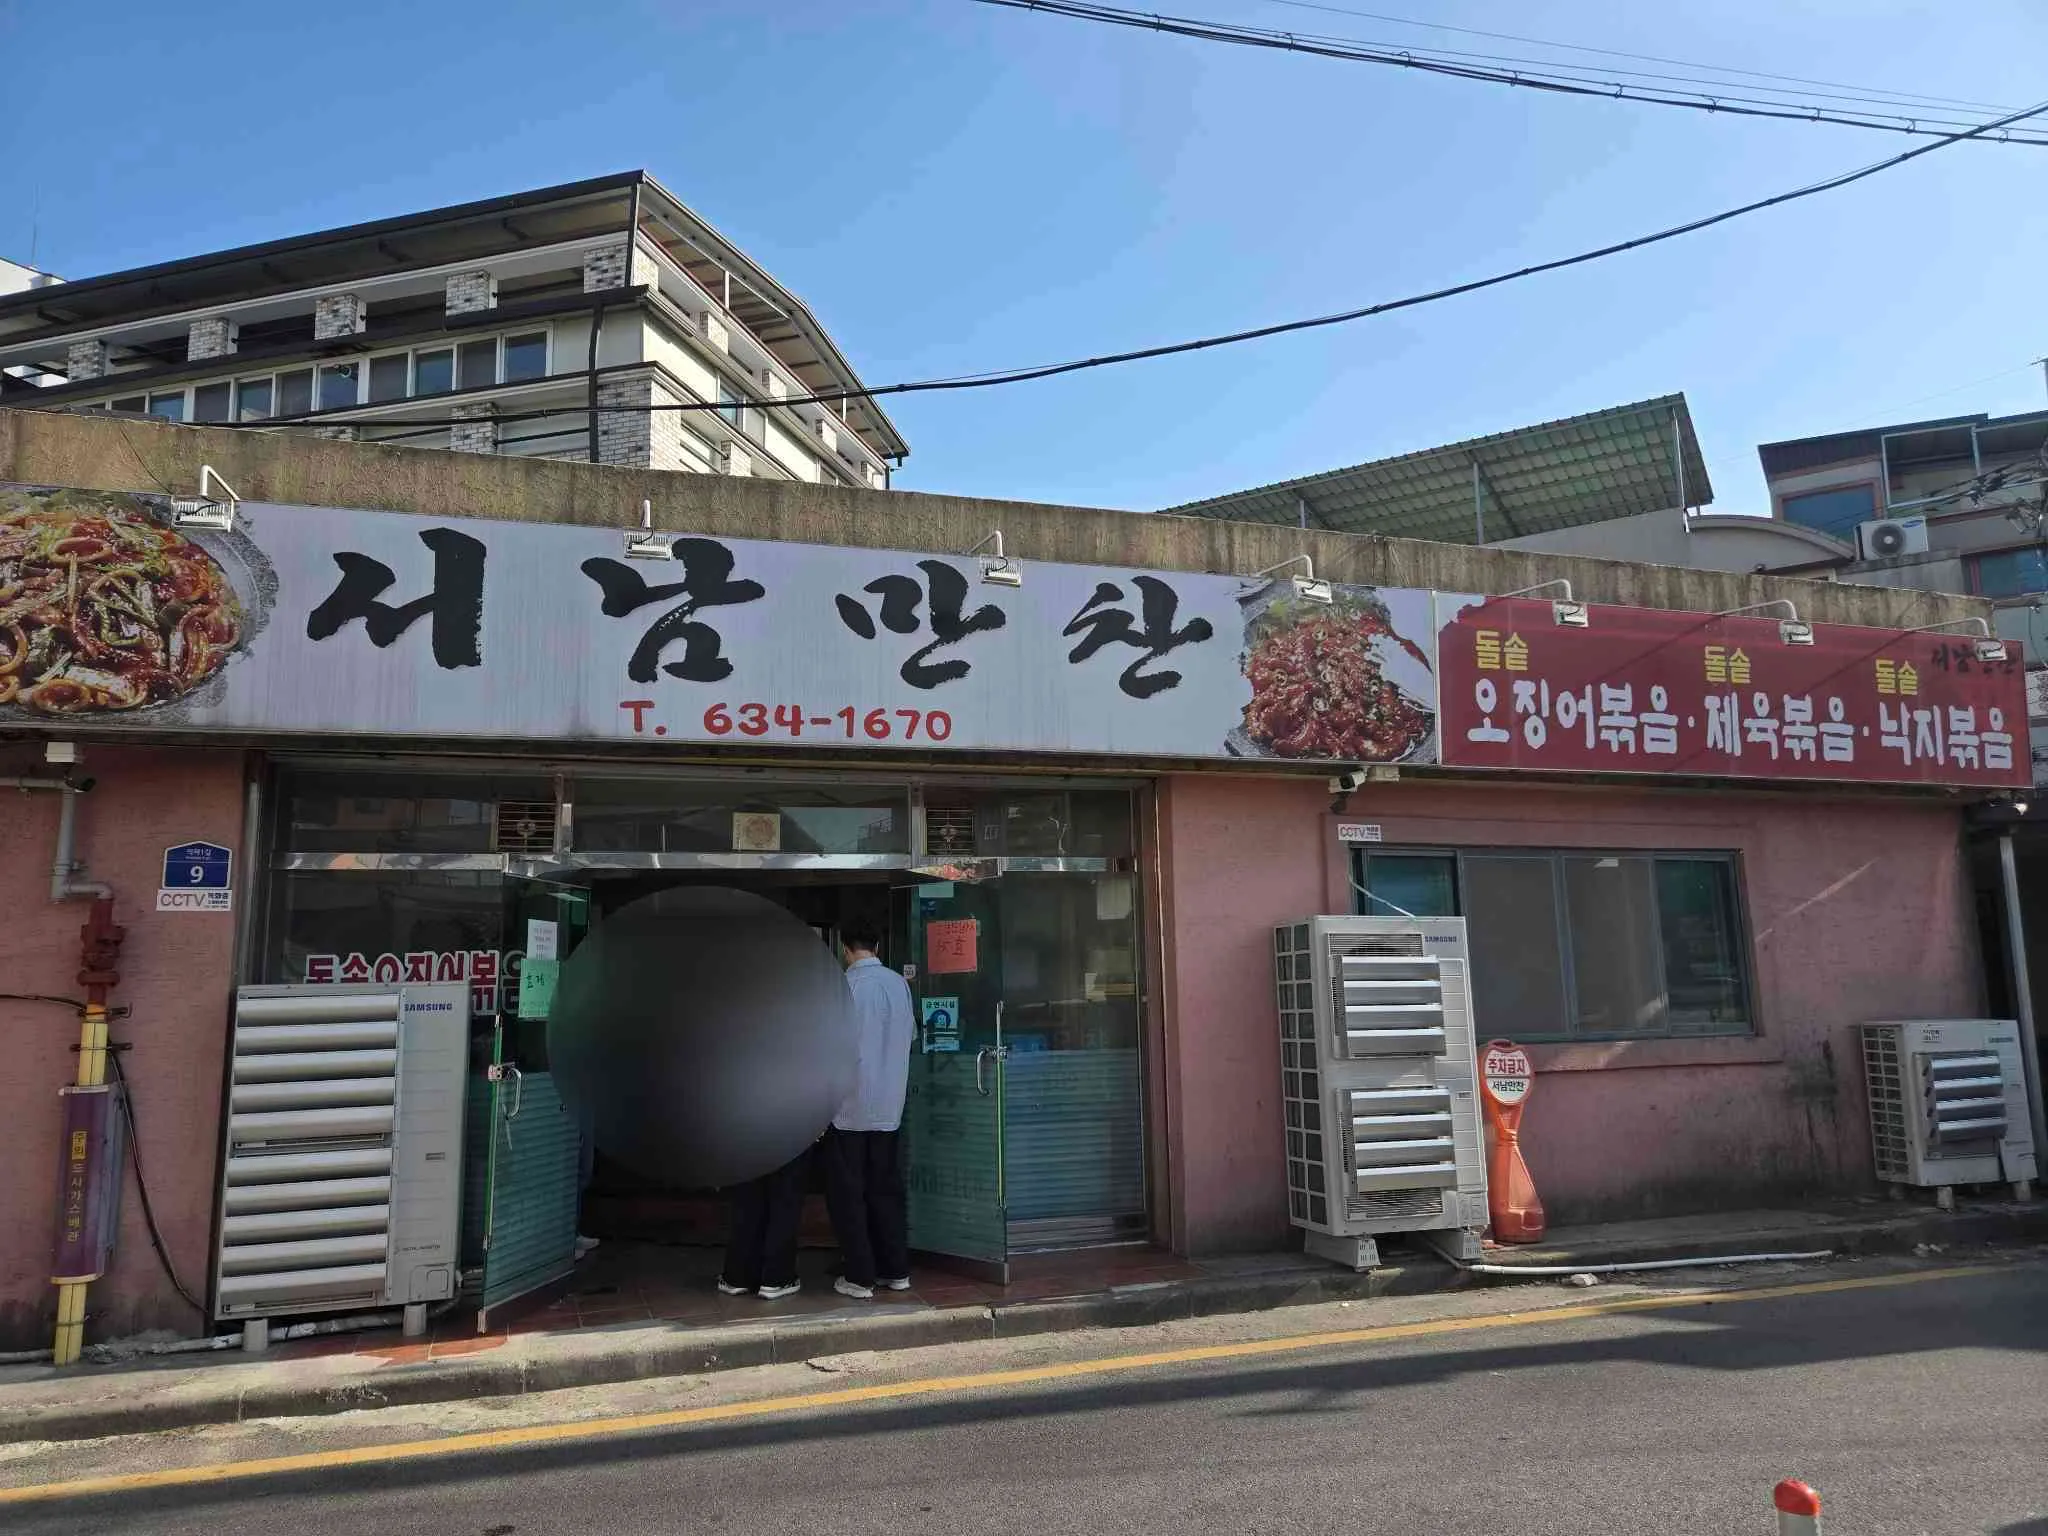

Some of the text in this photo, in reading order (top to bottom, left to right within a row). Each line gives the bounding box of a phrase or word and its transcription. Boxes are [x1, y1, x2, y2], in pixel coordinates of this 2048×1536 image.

[307, 527, 1213, 699] 서남만찬
[1475, 630, 1529, 671] 돌솥
[1704, 646, 1751, 684] 돌솥
[1875, 659, 1918, 695] 돌솥
[620, 701, 952, 741] T. 634-1670
[1879, 701, 2013, 770] 낙지볶음
[1340, 827, 1366, 838] CCTV
[190, 865, 204, 884] 9
[161, 893, 206, 907] CCTV
[404, 1002, 453, 1012] SAMSUNG
[1488, 1058, 1526, 1073] 주차금지
